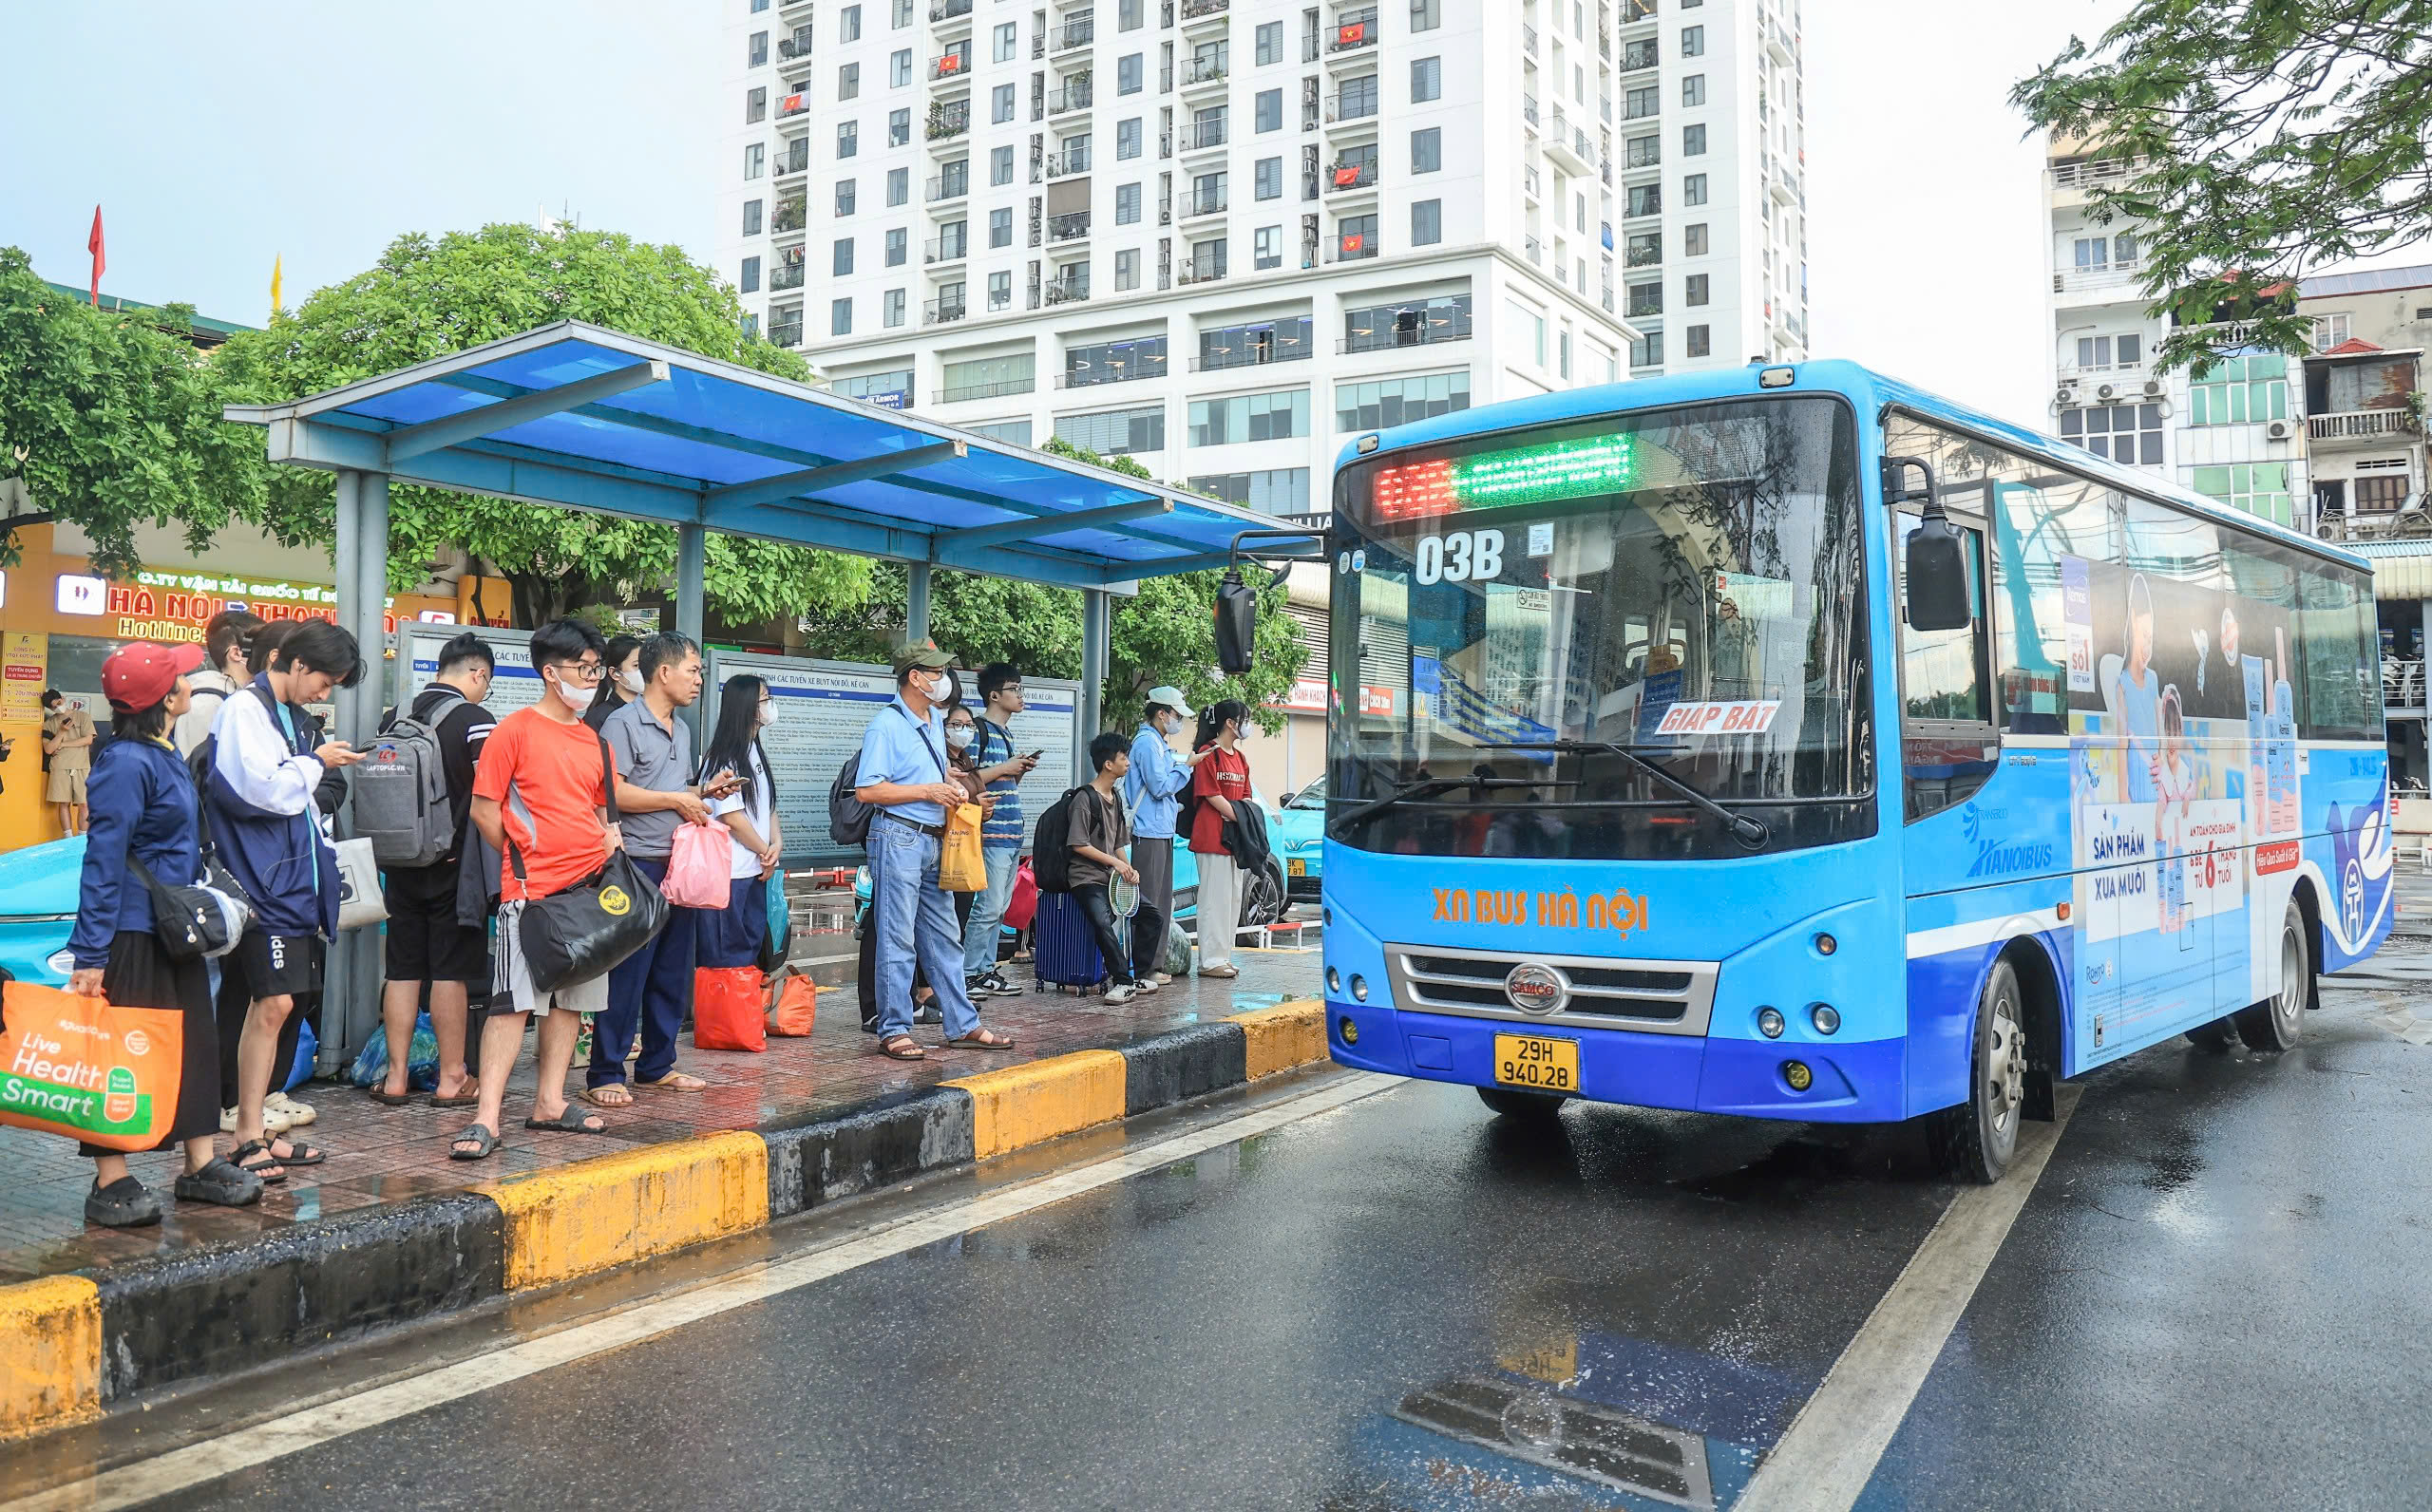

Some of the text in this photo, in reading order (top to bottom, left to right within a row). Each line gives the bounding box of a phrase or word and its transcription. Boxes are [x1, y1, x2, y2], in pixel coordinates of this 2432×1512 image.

[1416, 529, 1505, 586] 03B
[180, 575, 218, 593] VẬN
[106, 584, 156, 616] HÀ
[165, 591, 224, 627] NỘI
[494, 650, 530, 662] CÁC TUYẾ
[777, 672, 788, 683] CÁC
[789, 673, 807, 684] TUYẾN
[808, 676, 815, 684] XE
[816, 675, 830, 686] BUÝT
[1660, 701, 1776, 732] GIÁP BÁT
[1966, 838, 2052, 878] HANOIBUS
[2093, 826, 2145, 861] SẢN PHẨM
[2205, 840, 2215, 889] 6
[2095, 875, 2117, 900] XUA
[1475, 889, 1529, 926] BUS
[1536, 883, 1579, 928] HÀ
[1586, 887, 1649, 941] NỘI
[270, 935, 286, 970] idas
[1511, 982, 1555, 996] SAMCO
[22, 1031, 62, 1055] Live
[1517, 1039, 1553, 1062] 29H
[1503, 1061, 1568, 1087] 940.28
[3, 1077, 94, 1118] Smart
